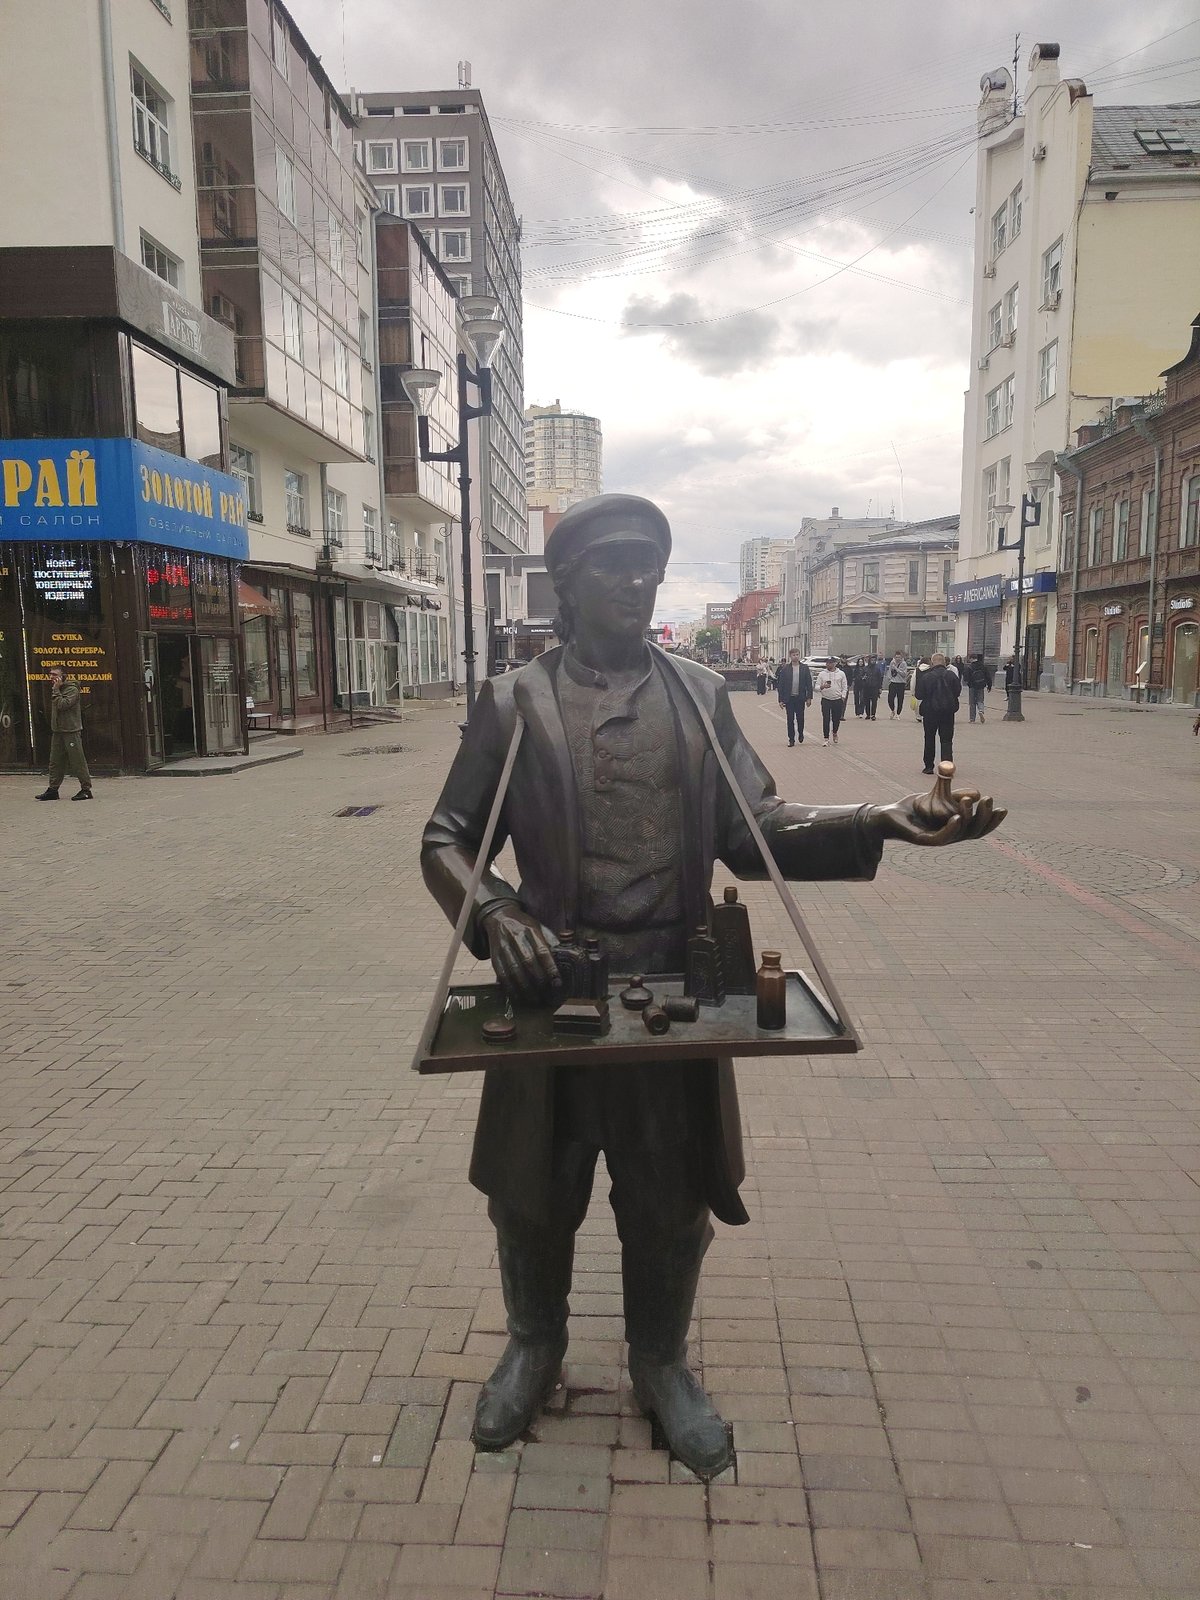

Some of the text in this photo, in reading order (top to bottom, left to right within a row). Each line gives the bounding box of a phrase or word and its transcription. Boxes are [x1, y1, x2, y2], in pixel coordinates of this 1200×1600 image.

[2, 450, 98, 507] РАЙ
[140, 464, 244, 528] ЗОЛОТОЙ РАЙ
[20, 515, 100, 526] САЛОН
[35, 580, 93, 589] ЮВЕЛИРНЫХ
[44, 589, 85, 601] ИЗДЕЛИЙ
[963, 585, 998, 603] AMERICANKA
[51, 633, 83, 641] СКУПКА
[71, 647, 106, 655] СЕРЕБРА,
[77, 672, 113, 681] ИЗДЕЛИЙ
